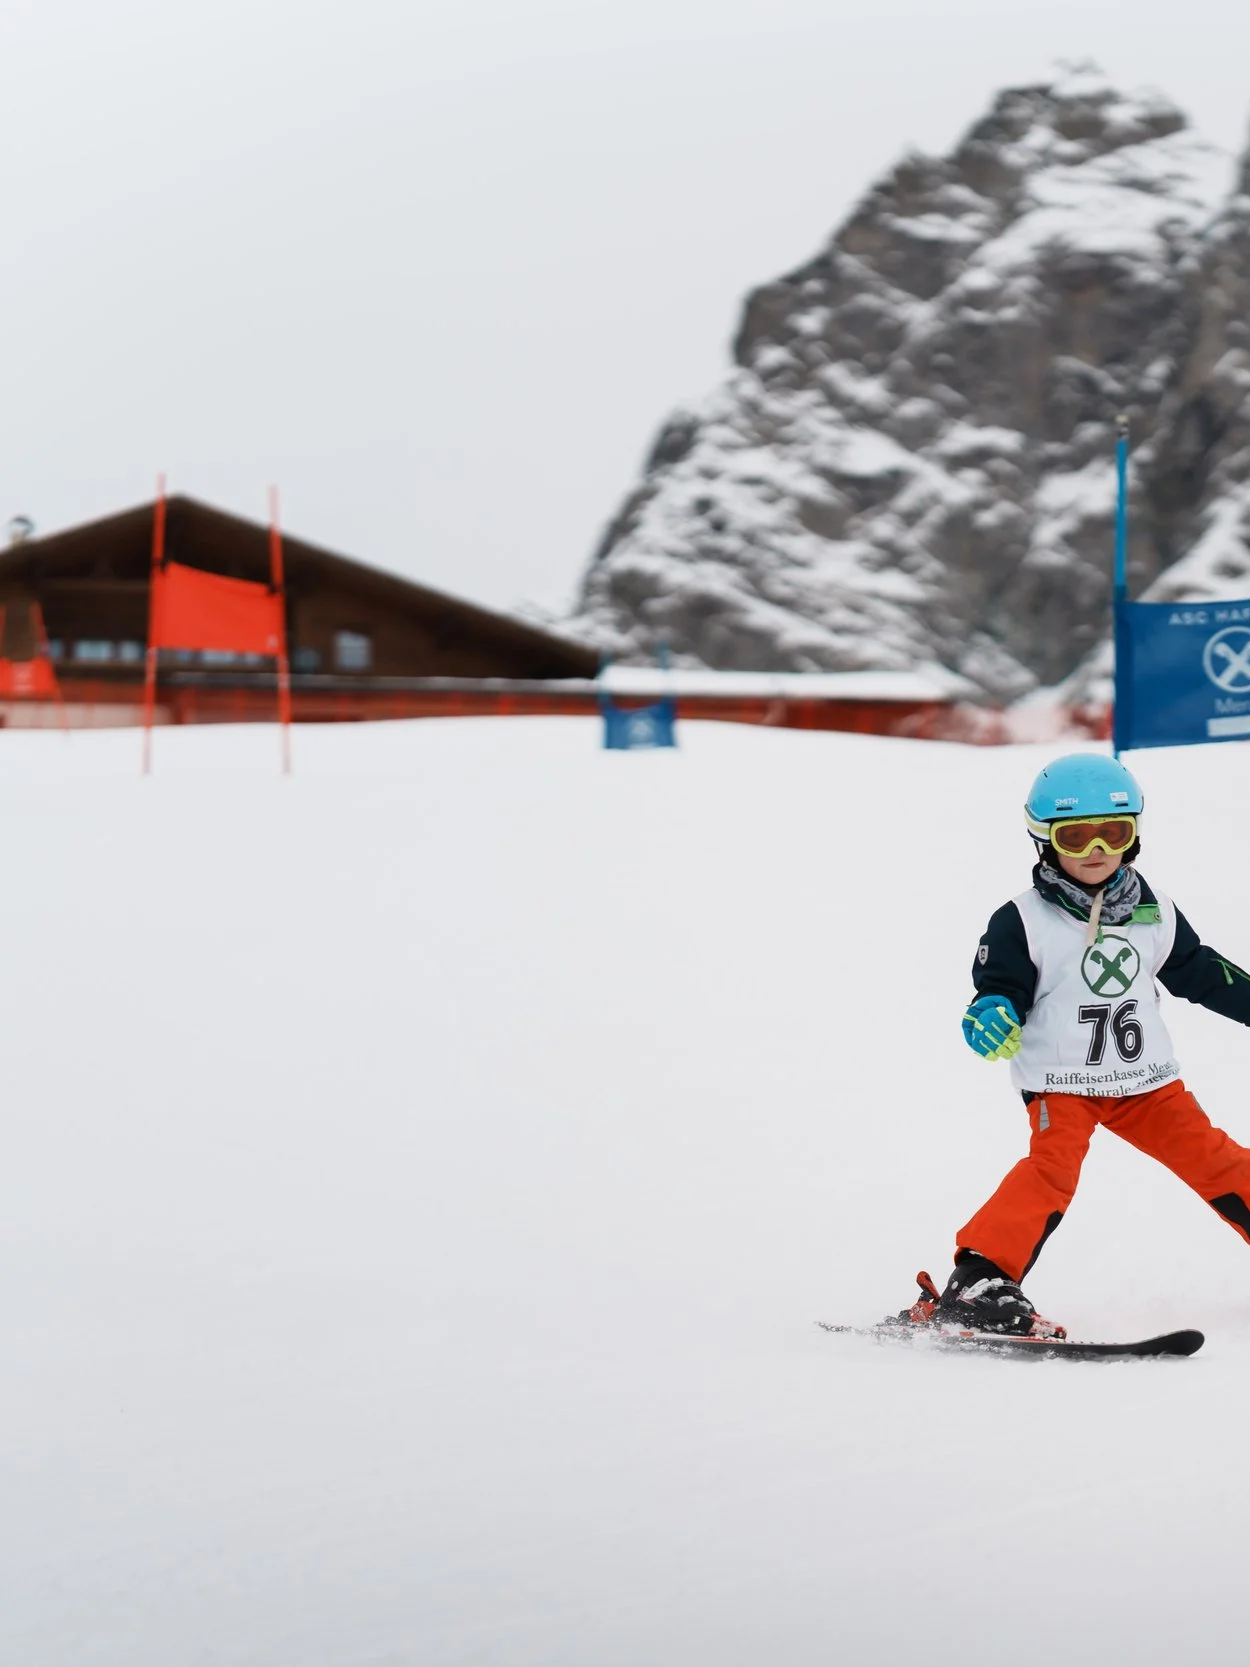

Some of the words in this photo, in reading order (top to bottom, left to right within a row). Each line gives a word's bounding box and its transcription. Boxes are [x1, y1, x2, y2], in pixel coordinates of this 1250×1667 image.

[1169, 611, 1208, 625] ASC
[1055, 797, 1079, 807] SMITH
[1078, 999, 1145, 1066] 76
[1045, 1069, 1145, 1085] Raiffeisenkasse
